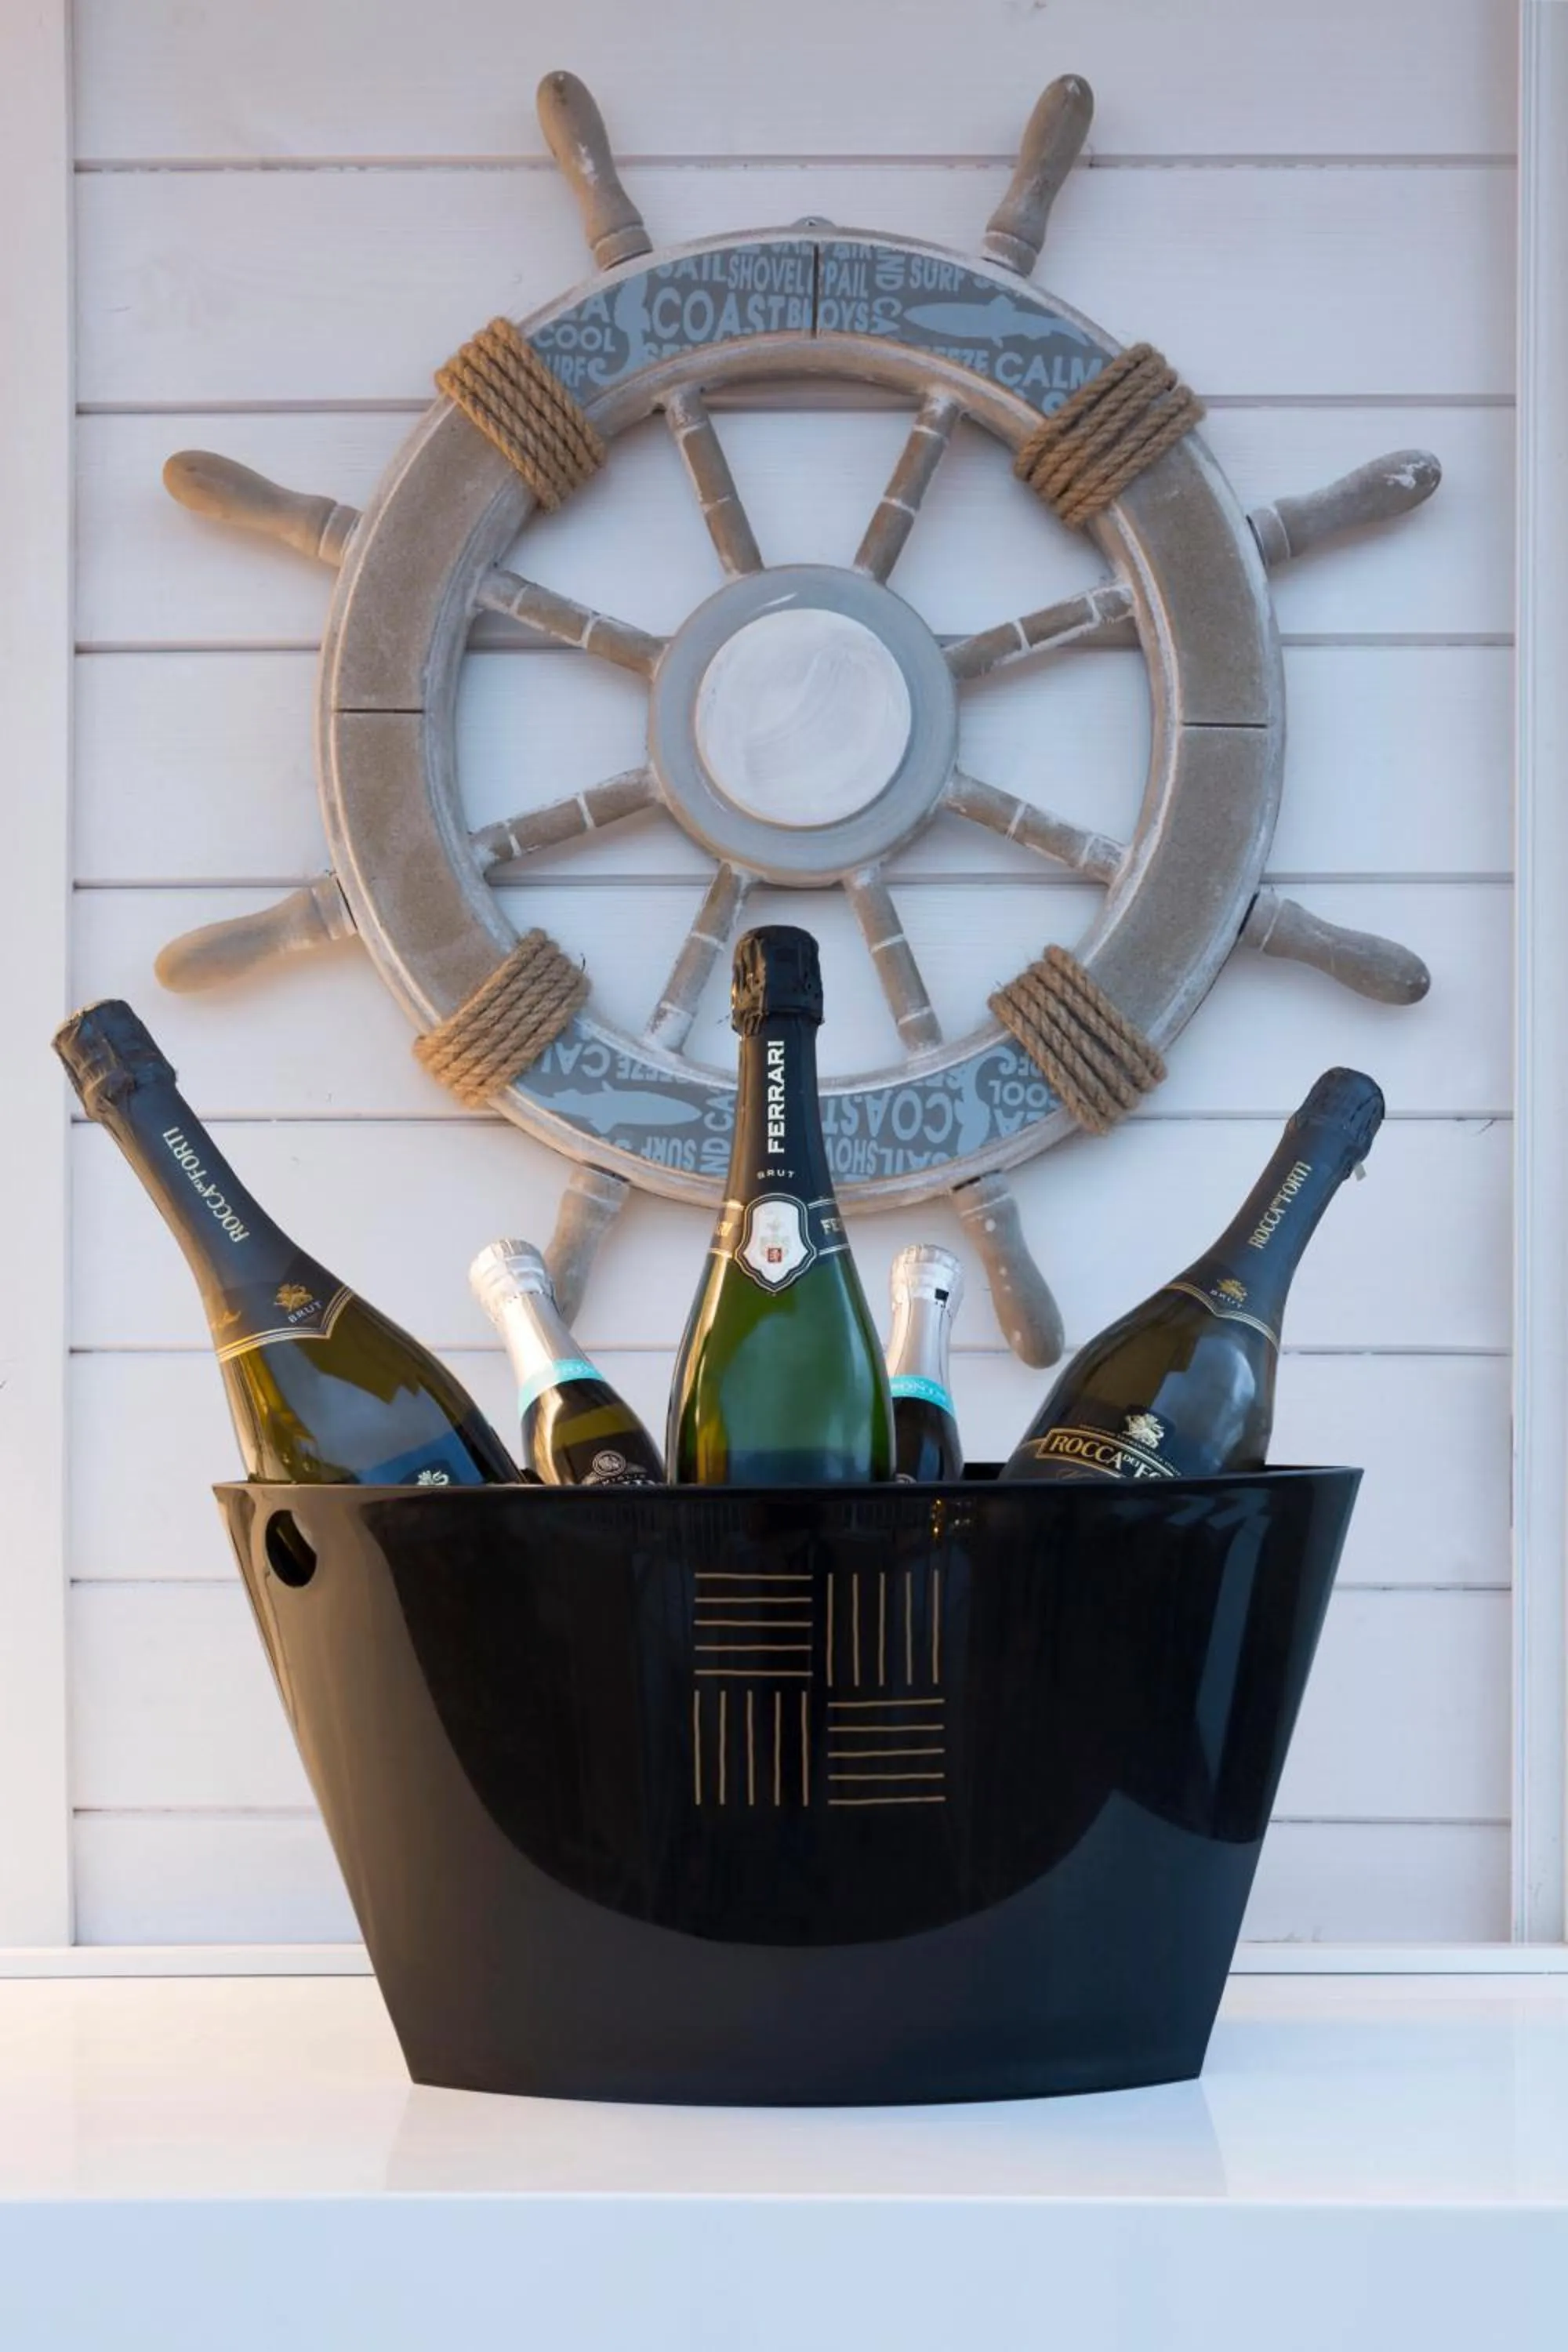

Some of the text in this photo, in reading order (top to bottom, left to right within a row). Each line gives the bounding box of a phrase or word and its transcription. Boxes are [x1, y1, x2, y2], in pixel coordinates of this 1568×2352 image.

[728, 254, 806, 295] SHOVEL
[824, 260, 869, 298] PAIL
[909, 255, 966, 292] SURF
[652, 285, 785, 343] COAST
[533, 323, 616, 353] COOL
[994, 351, 1103, 390] CALM
[767, 1040, 786, 1154] FERRARI
[162, 1126, 208, 1181] FORTI
[757, 1168, 796, 1180] BRUT
[201, 1183, 251, 1243] ROCCA
[1247, 1207, 1286, 1250] ROCCA
[1277, 1160, 1312, 1203] FORTI
[287, 1299, 323, 1324] BRUT
[1049, 1435, 1123, 1471] ROCCA
